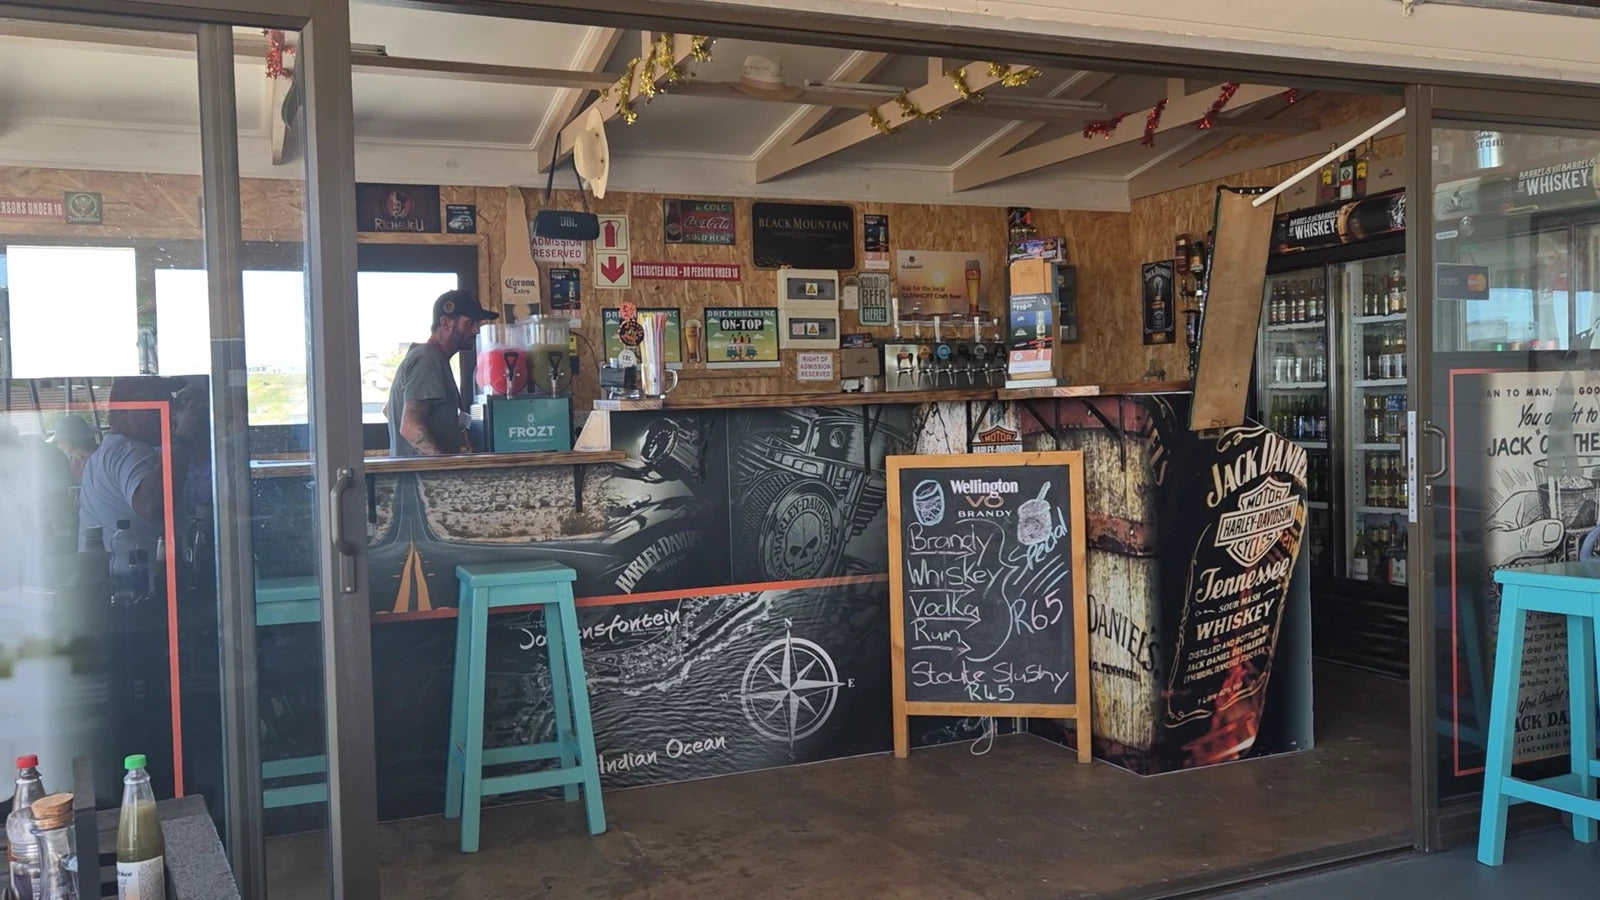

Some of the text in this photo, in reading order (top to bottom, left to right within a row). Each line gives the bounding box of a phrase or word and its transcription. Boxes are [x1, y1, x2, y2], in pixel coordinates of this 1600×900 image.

[1526, 168, 1589, 197] WHISKEY
[28, 202, 53, 216] UNDER
[560, 216, 578, 228] JBL
[683, 215, 731, 230] Coca-Cola
[758, 217, 849, 231] BLACK MOUNTAIN
[1294, 218, 1337, 241] WHISKEY
[531, 237, 582, 247] ADMISSION
[532, 249, 582, 258] RESERVED
[632, 265, 664, 277] RESTRICTED
[665, 265, 678, 277] AREA
[683, 266, 691, 277] NO
[691, 266, 714, 278] PERSONS
[715, 267, 731, 278] UNDER
[732, 267, 738, 278] 18
[861, 276, 879, 288] COLD
[505, 278, 535, 289] Corona
[862, 290, 886, 306] BEER
[721, 319, 762, 330] ON-TOP
[1506, 389, 1520, 398] TO
[1526, 387, 1552, 398] MAN,
[1578, 386, 1600, 396] GOO
[1517, 403, 1542, 428] You
[1586, 405, 1598, 423] to
[984, 432, 1012, 442] MOTOR
[1486, 436, 1532, 458] JACK
[1206, 446, 1259, 508] JACK
[950, 478, 1019, 499] Wellington
[1246, 487, 1281, 509] MOTOR
[965, 495, 1005, 508] VO
[958, 510, 1012, 518] BRANDY
[1222, 505, 1292, 538] HARLEY-DAVIDSON
[774, 496, 831, 556] HARLEY-DAVIDSON
[907, 522, 994, 566] Brandy
[1235, 531, 1274, 560] CYCLES
[907, 555, 1005, 599] Whiskey
[1195, 558, 1290, 603] Tennessee
[909, 592, 980, 618] Vodka
[1012, 588, 1064, 635] R65
[1218, 592, 1262, 614] SOUR MASH
[784, 617, 793, 628] N
[911, 618, 961, 643] Rum
[1196, 598, 1276, 642] WHISKEY
[1188, 642, 1222, 660] DISTILLED
[1187, 661, 1206, 673] JACK
[1207, 652, 1231, 666] DANIEL
[847, 678, 856, 688] E
[992, 661, 1069, 694] Slushy
[964, 683, 1015, 701] R45
[1515, 713, 1544, 733] ACK
[599, 736, 727, 775] Indian Ocean
